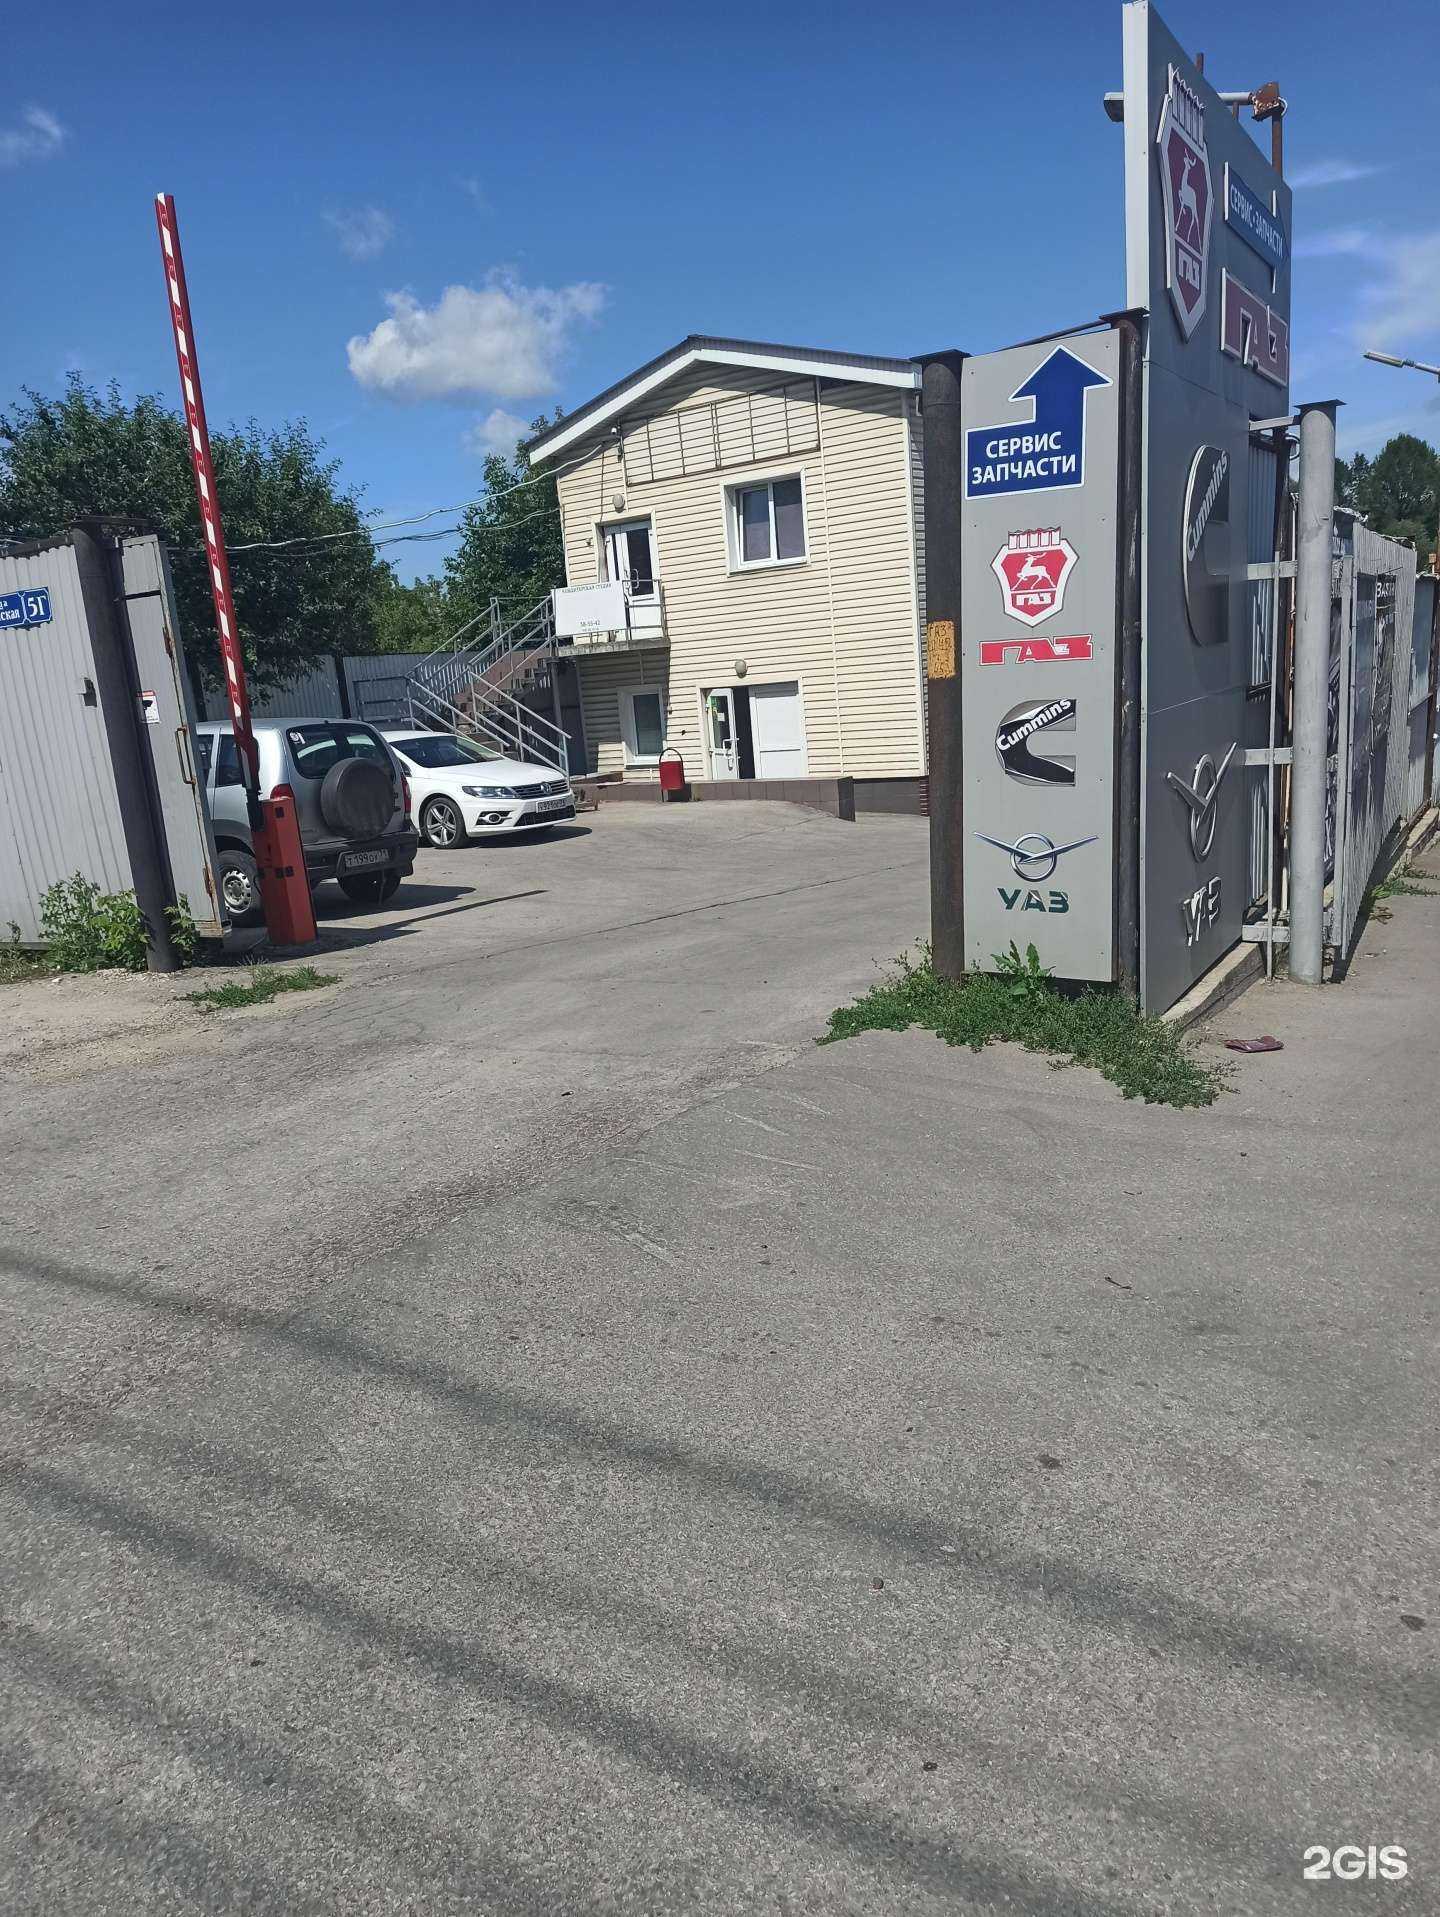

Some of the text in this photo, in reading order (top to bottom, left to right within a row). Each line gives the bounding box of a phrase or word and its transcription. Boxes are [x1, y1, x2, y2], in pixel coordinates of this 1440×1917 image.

[1230, 183, 1253, 228] СЕРВИС
[1178, 247, 1200, 291] ГАЗ
[986, 430, 1062, 459] СЕРВИС
[971, 453, 1077, 485] ЗАПЧАСТИ
[1187, 450, 1228, 562] Cummins
[0, 609, 20, 621] ская
[27, 595, 47, 617] 5Г
[1015, 592, 1052, 606] ГАЗ
[979, 634, 1094, 666] ГАЗ
[995, 698, 1072, 751] Cummins
[996, 887, 1070, 914] УАЗ
